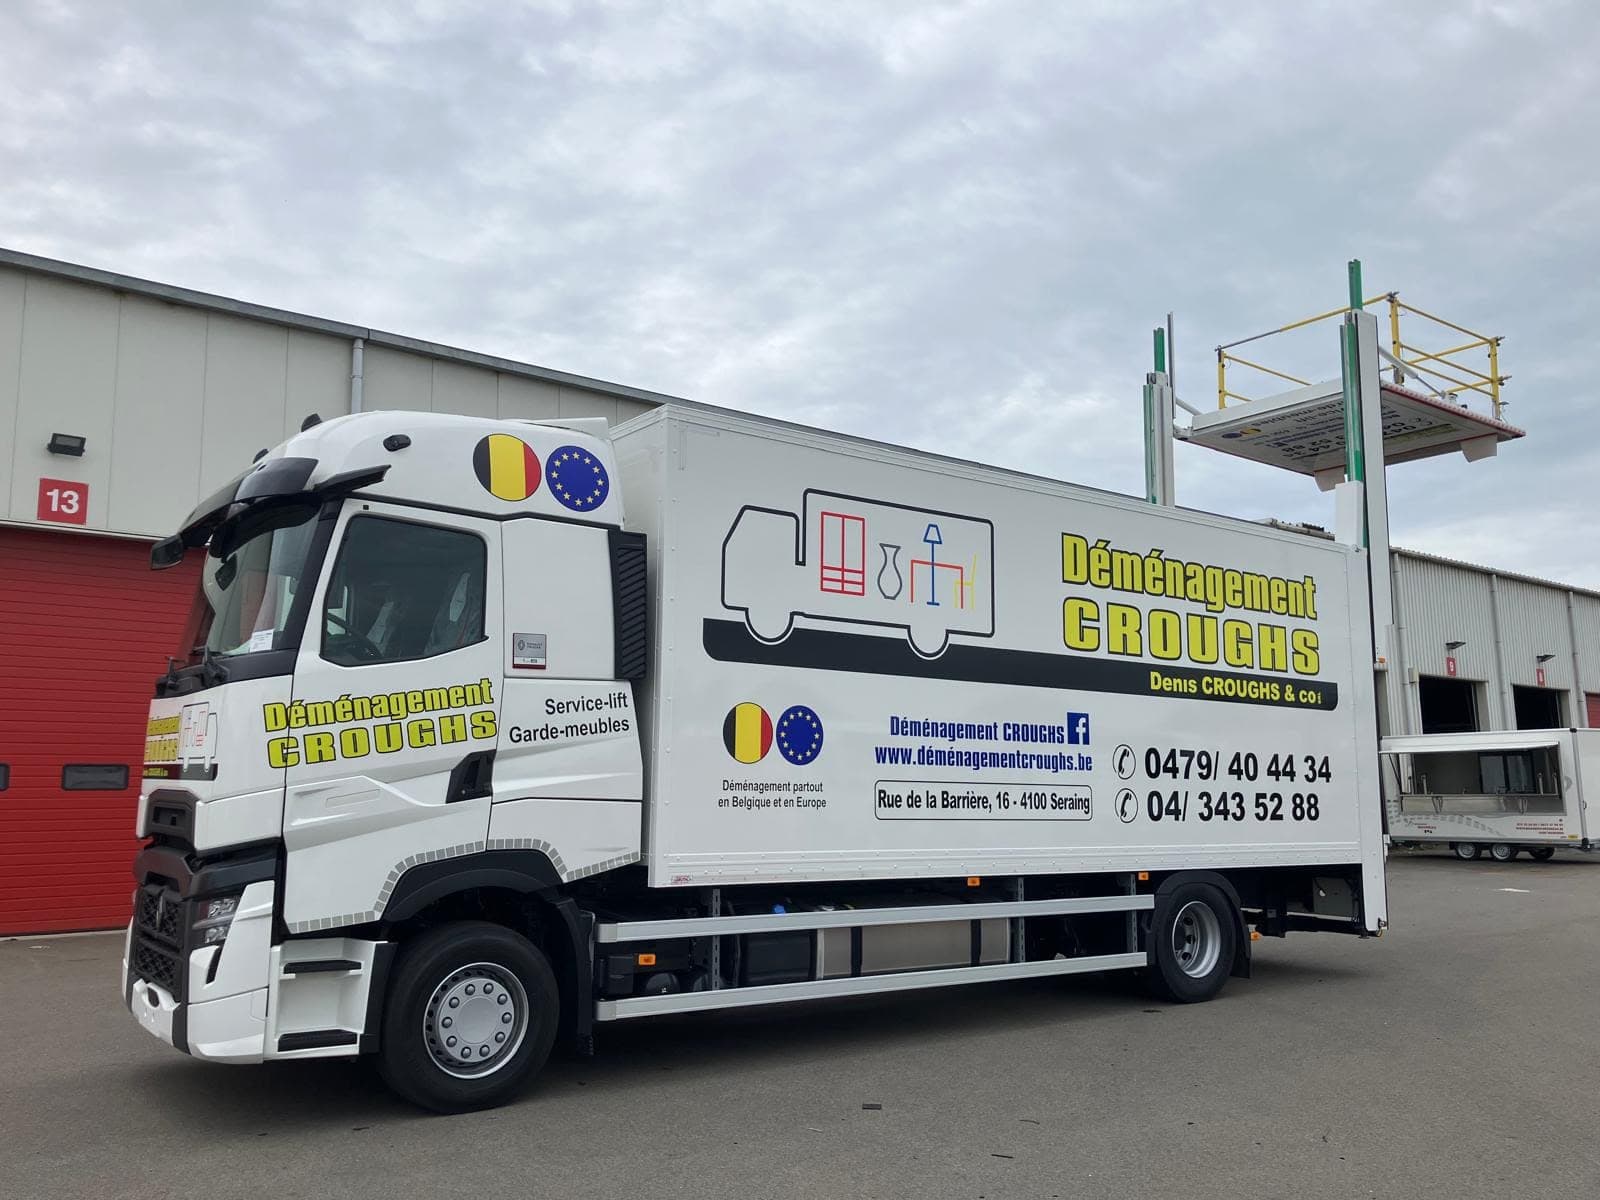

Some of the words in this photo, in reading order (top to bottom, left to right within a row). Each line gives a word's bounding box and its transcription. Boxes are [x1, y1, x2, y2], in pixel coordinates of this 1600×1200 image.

[46, 489, 79, 514] 13
[1061, 532, 1318, 620] Déménagement
[1062, 596, 1320, 676] CROUGHS
[1150, 671, 1198, 693] Denis
[1201, 675, 1280, 701] CROUGHS
[1284, 684, 1295, 702] &
[263, 677, 494, 732] Déménagement
[545, 691, 628, 715] Service-lift
[266, 710, 497, 769] CROUGHS
[509, 717, 630, 743] Garde-meubles
[890, 716, 998, 742] Déménagement
[1003, 723, 1065, 744] CROUGHS
[874, 745, 1093, 773] www.déménagementcroughs.be
[1144, 747, 1219, 780] 0479/
[1228, 752, 1258, 782] 40
[1267, 753, 1296, 782] 44
[1303, 755, 1332, 783] 34
[722, 779, 791, 794] Déménagement
[793, 781, 824, 794] partout
[718, 798, 729, 807] en
[732, 796, 771, 810] Belgique
[773, 797, 782, 807] et
[783, 798, 794, 807] en
[796, 796, 827, 810] Europe
[878, 789, 902, 809] Rue
[906, 790, 921, 809] de
[926, 790, 937, 809] la
[941, 790, 992, 813] Barrière,
[996, 792, 1009, 810] 16
[1020, 792, 1047, 810] 4100
[1050, 793, 1090, 814] Seraing
[1147, 790, 1189, 822] 04/
[1198, 791, 1245, 822] 343
[1254, 792, 1284, 821] 52
[1292, 793, 1320, 822] 88
